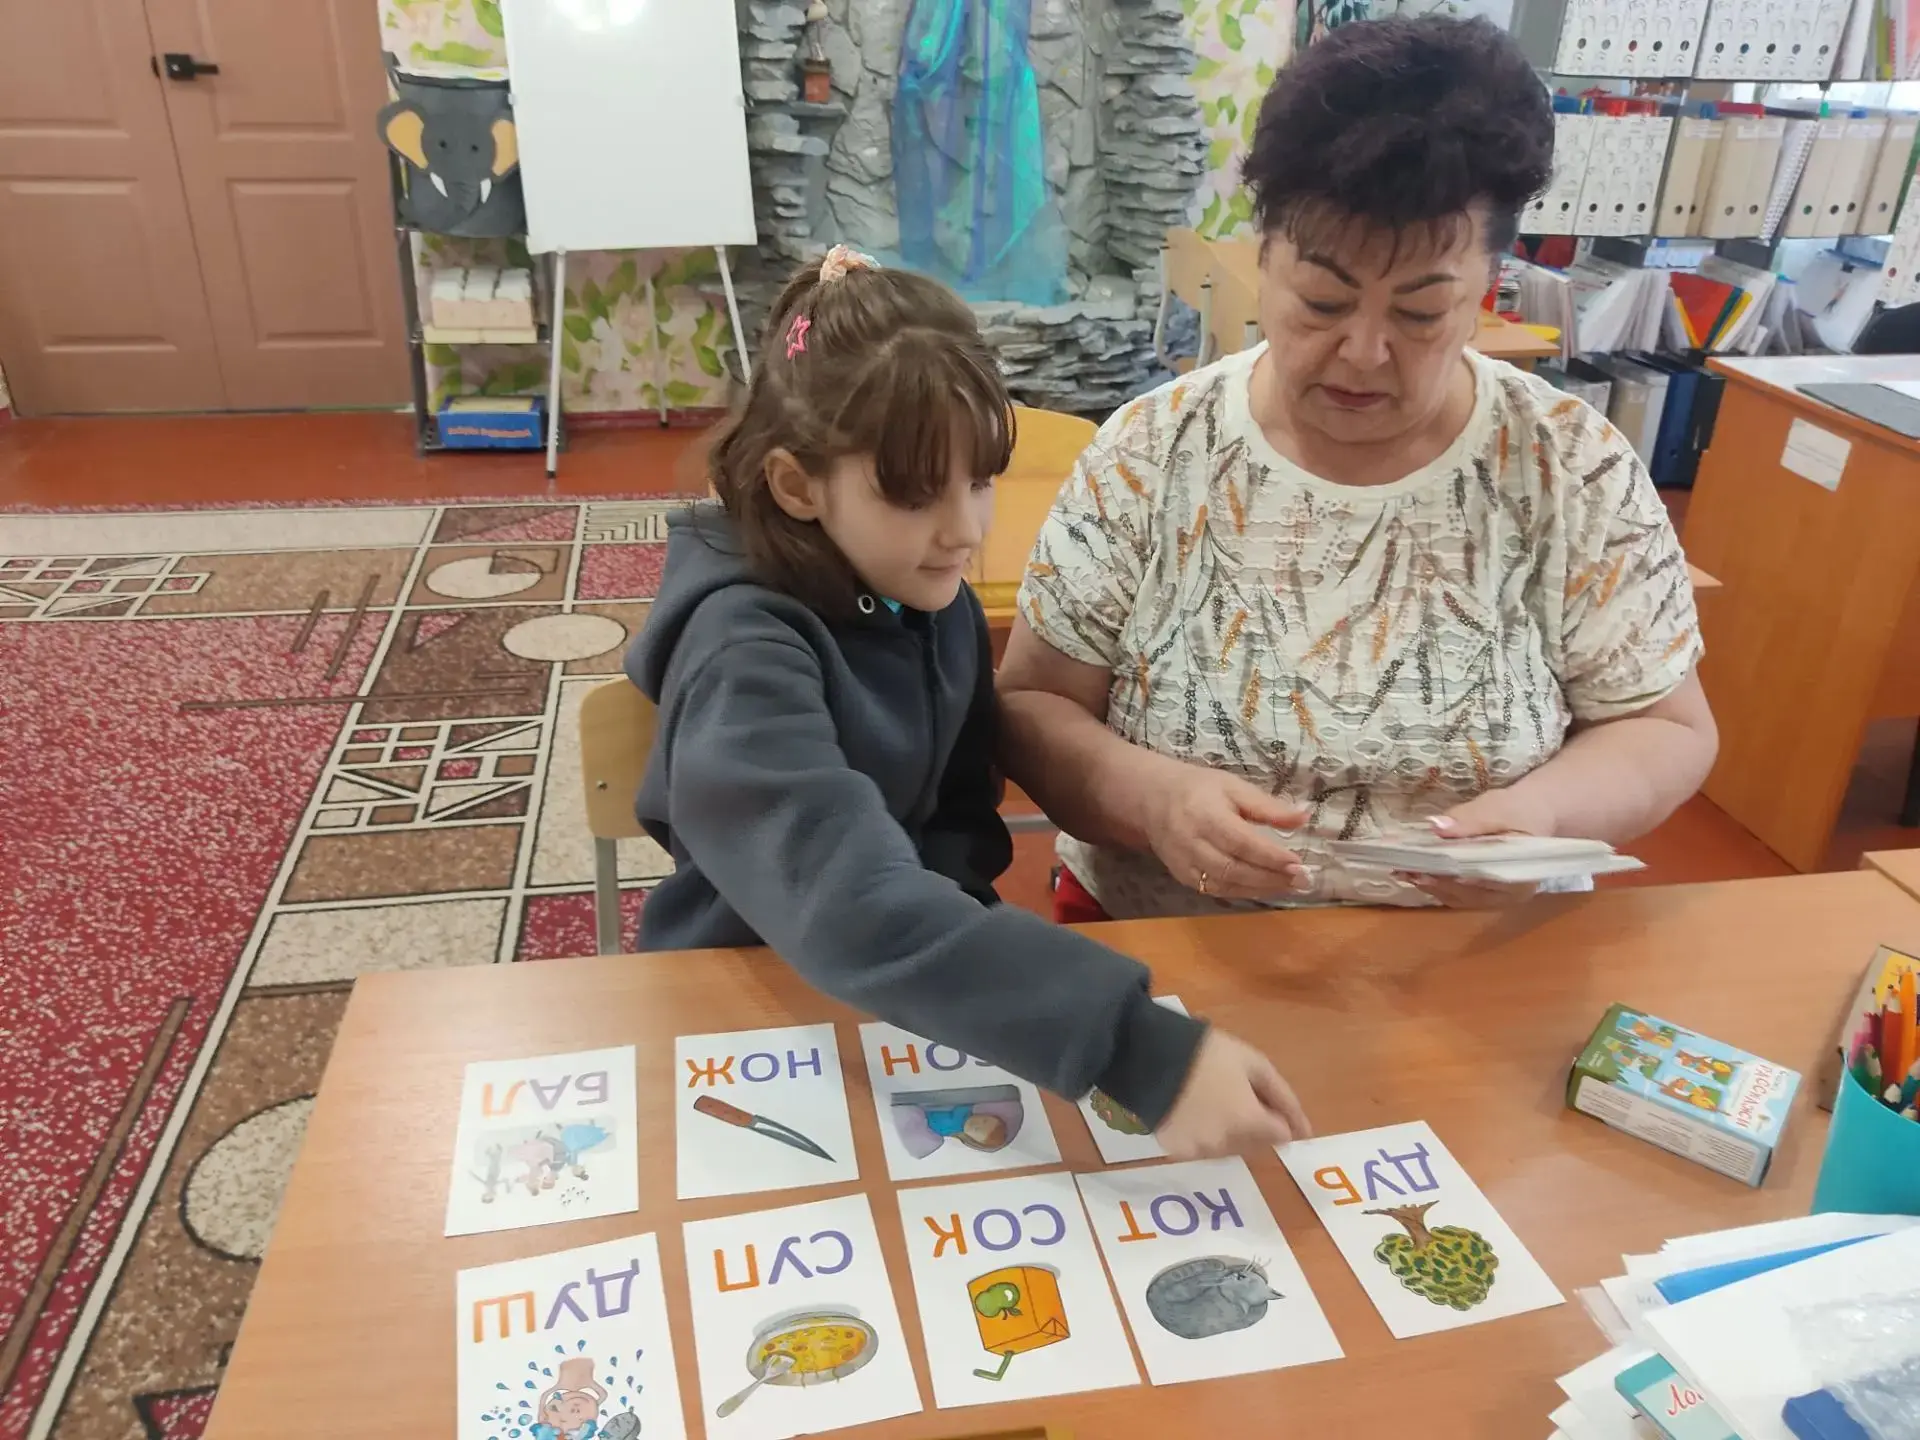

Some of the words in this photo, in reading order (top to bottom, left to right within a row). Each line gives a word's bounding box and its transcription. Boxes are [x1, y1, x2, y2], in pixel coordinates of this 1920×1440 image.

[481, 1070, 609, 1120] БАЛ
[686, 1047, 823, 1088] НОЖ
[1313, 1142, 1440, 1206] ДУБ
[924, 1203, 1066, 1258] СОК
[1117, 1188, 1244, 1243] КОТ
[714, 1230, 854, 1292] СУП
[472, 1258, 641, 1344] ДУШ
